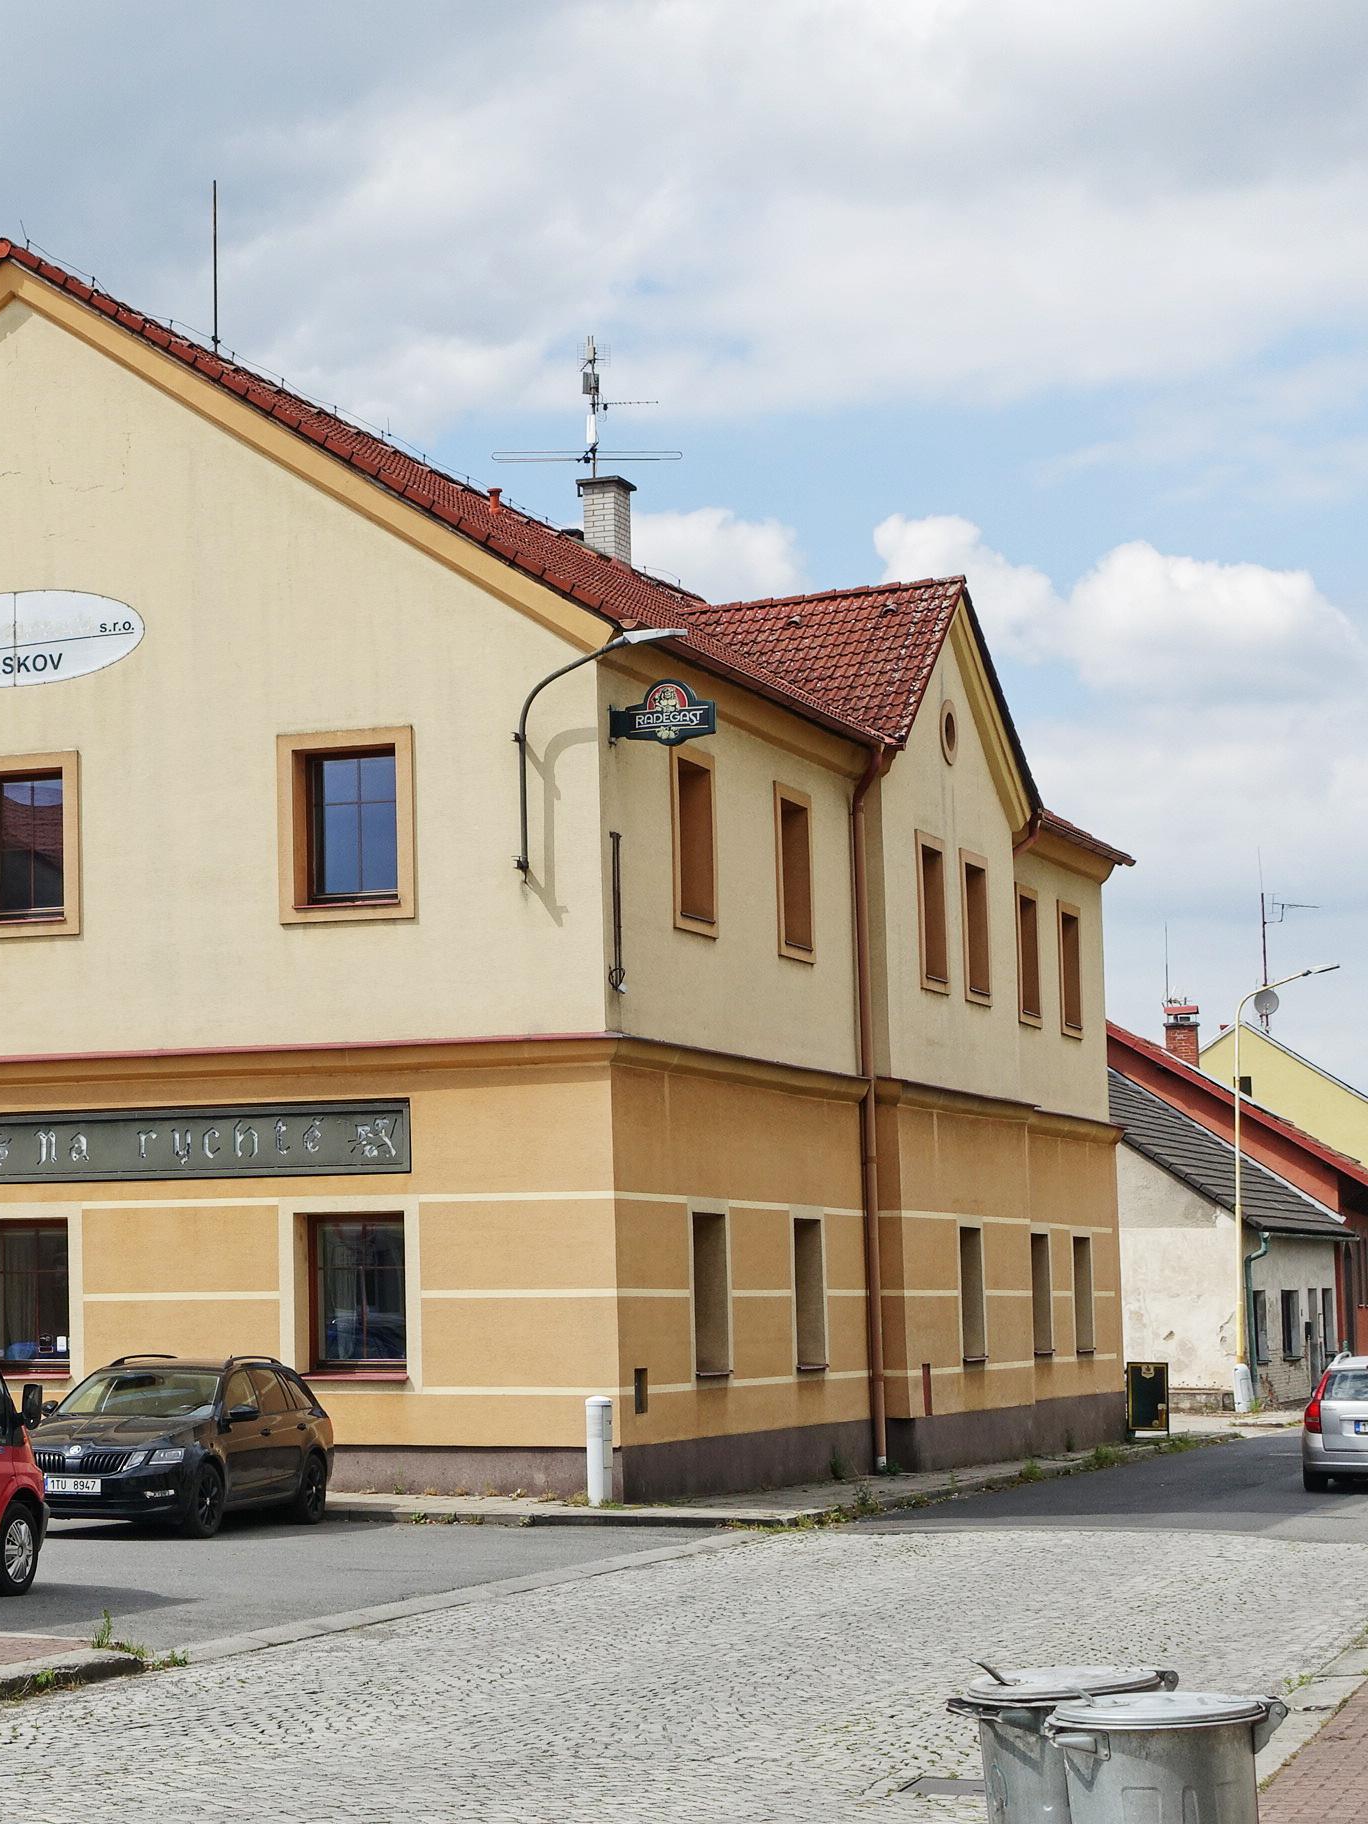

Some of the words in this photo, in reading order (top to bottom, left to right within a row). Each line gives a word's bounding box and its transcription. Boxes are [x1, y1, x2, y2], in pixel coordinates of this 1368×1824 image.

[99, 620, 135, 633] s.r.o.
[635, 710, 704, 728] RADEGAST
[50, 1479, 67, 1490] 1TU
[73, 1480, 96, 1491] 8947
